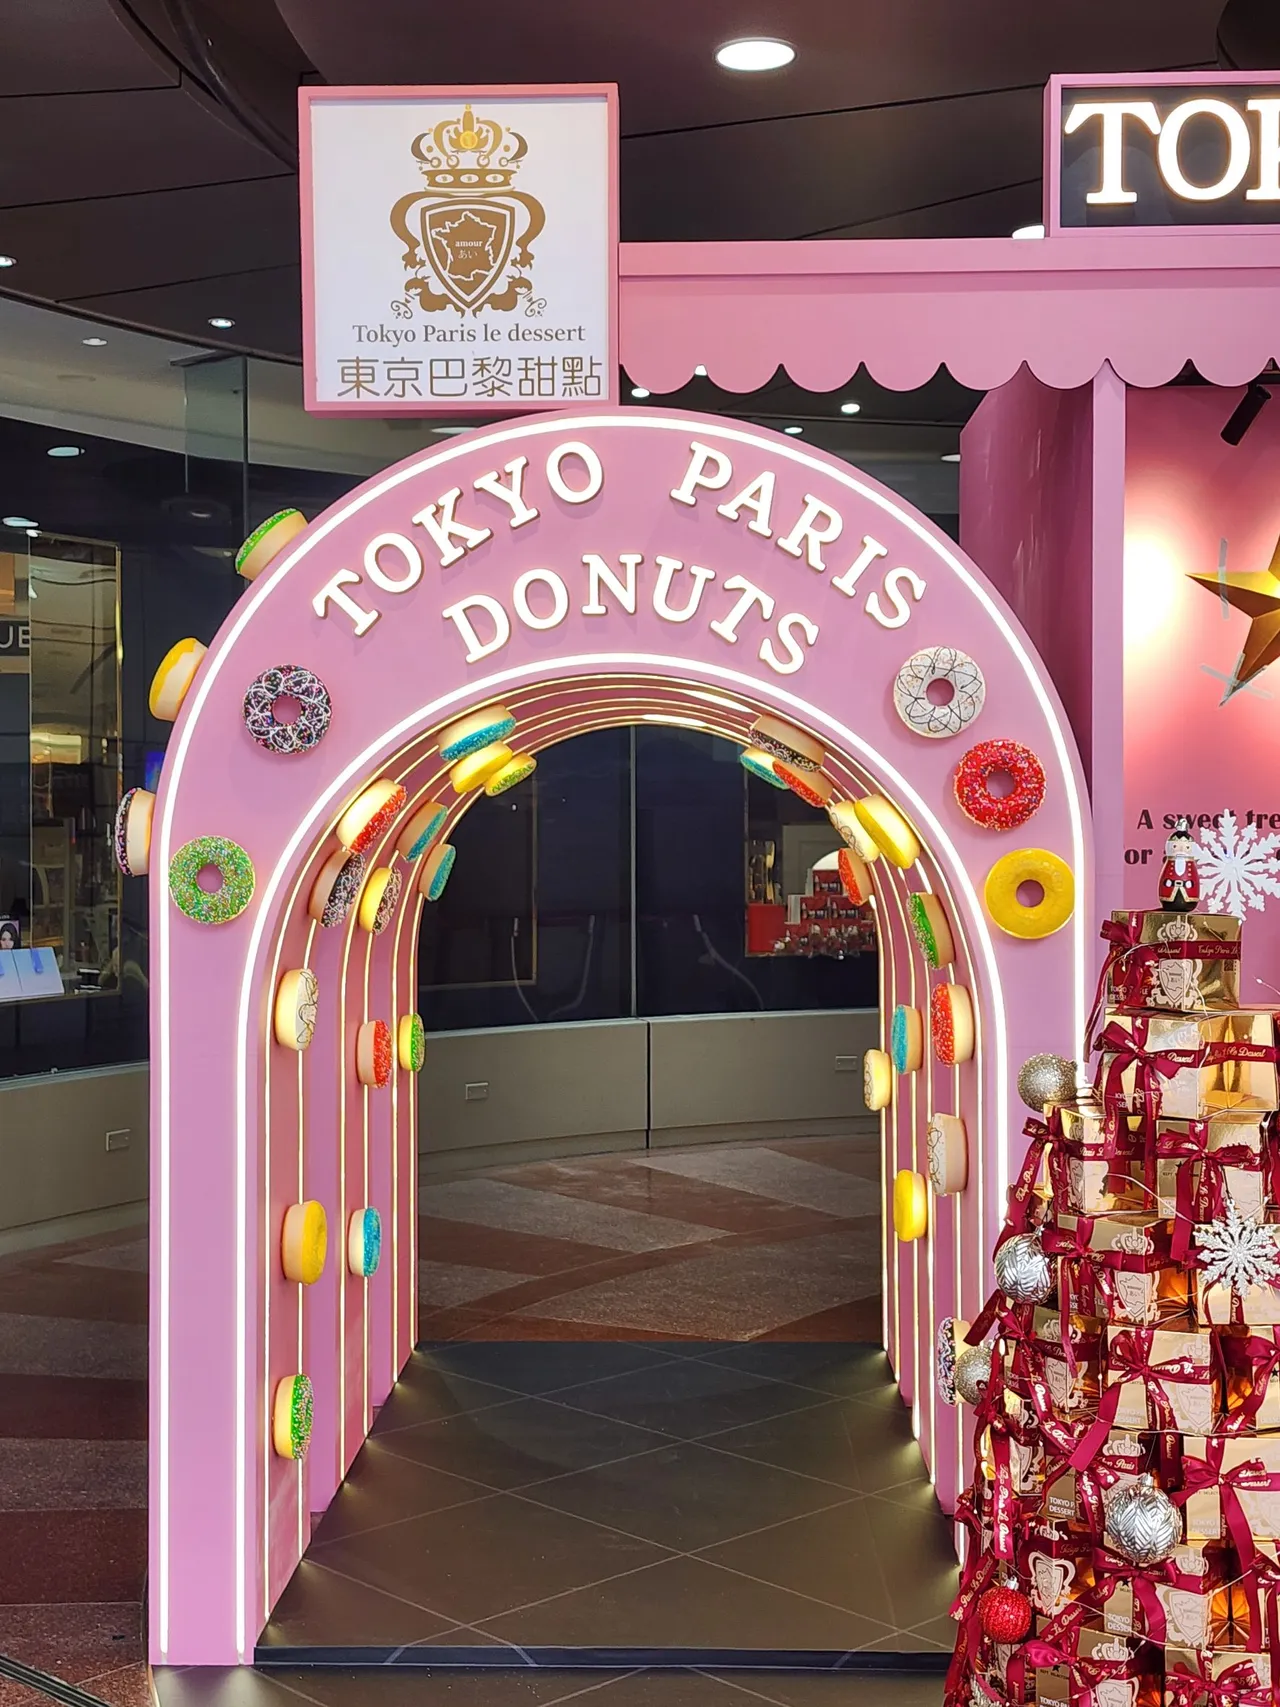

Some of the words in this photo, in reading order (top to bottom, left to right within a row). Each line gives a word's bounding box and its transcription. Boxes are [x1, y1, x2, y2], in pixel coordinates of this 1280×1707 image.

[352, 324, 416, 347] Tokyo
[423, 324, 476, 342] Paris
[483, 323, 501, 342] le
[508, 323, 586, 342] dessert
[337, 355, 602, 399] 東京巴黎甜點
[312, 440, 603, 636] TOKYO
[671, 441, 927, 630] PARIS
[442, 553, 819, 675] DONUTS
[1137, 809, 1154, 830] A
[1124, 848, 1152, 865] or
[1049, 1496, 1070, 1507] TOKYO
